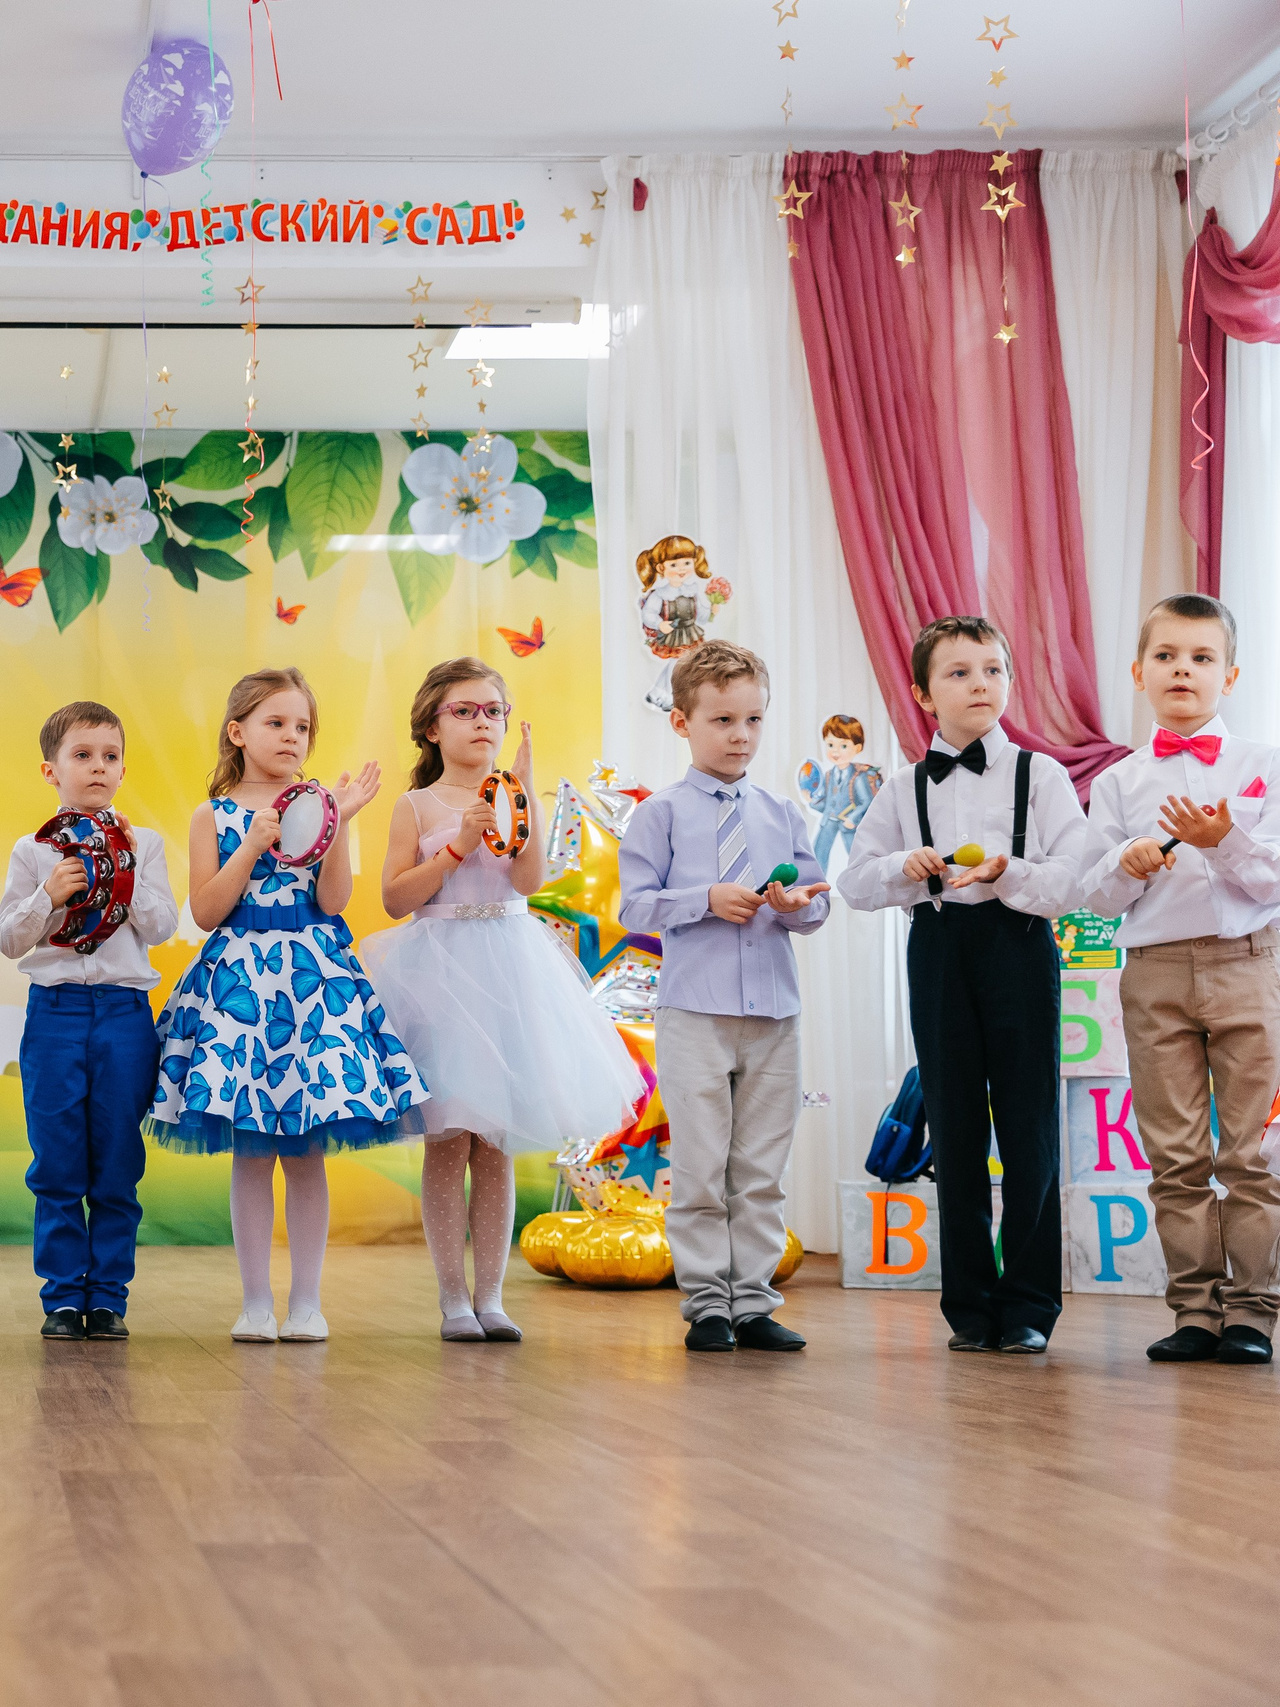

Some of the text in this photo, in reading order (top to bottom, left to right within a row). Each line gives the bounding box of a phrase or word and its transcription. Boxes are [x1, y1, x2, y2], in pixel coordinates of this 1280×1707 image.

[166, 200, 370, 252] ДЕТСКИЙ
[405, 202, 516, 246] САД!
[1088, 1088, 1152, 1171] К
[865, 1191, 929, 1275] В
[1089, 1195, 1148, 1282] Р
